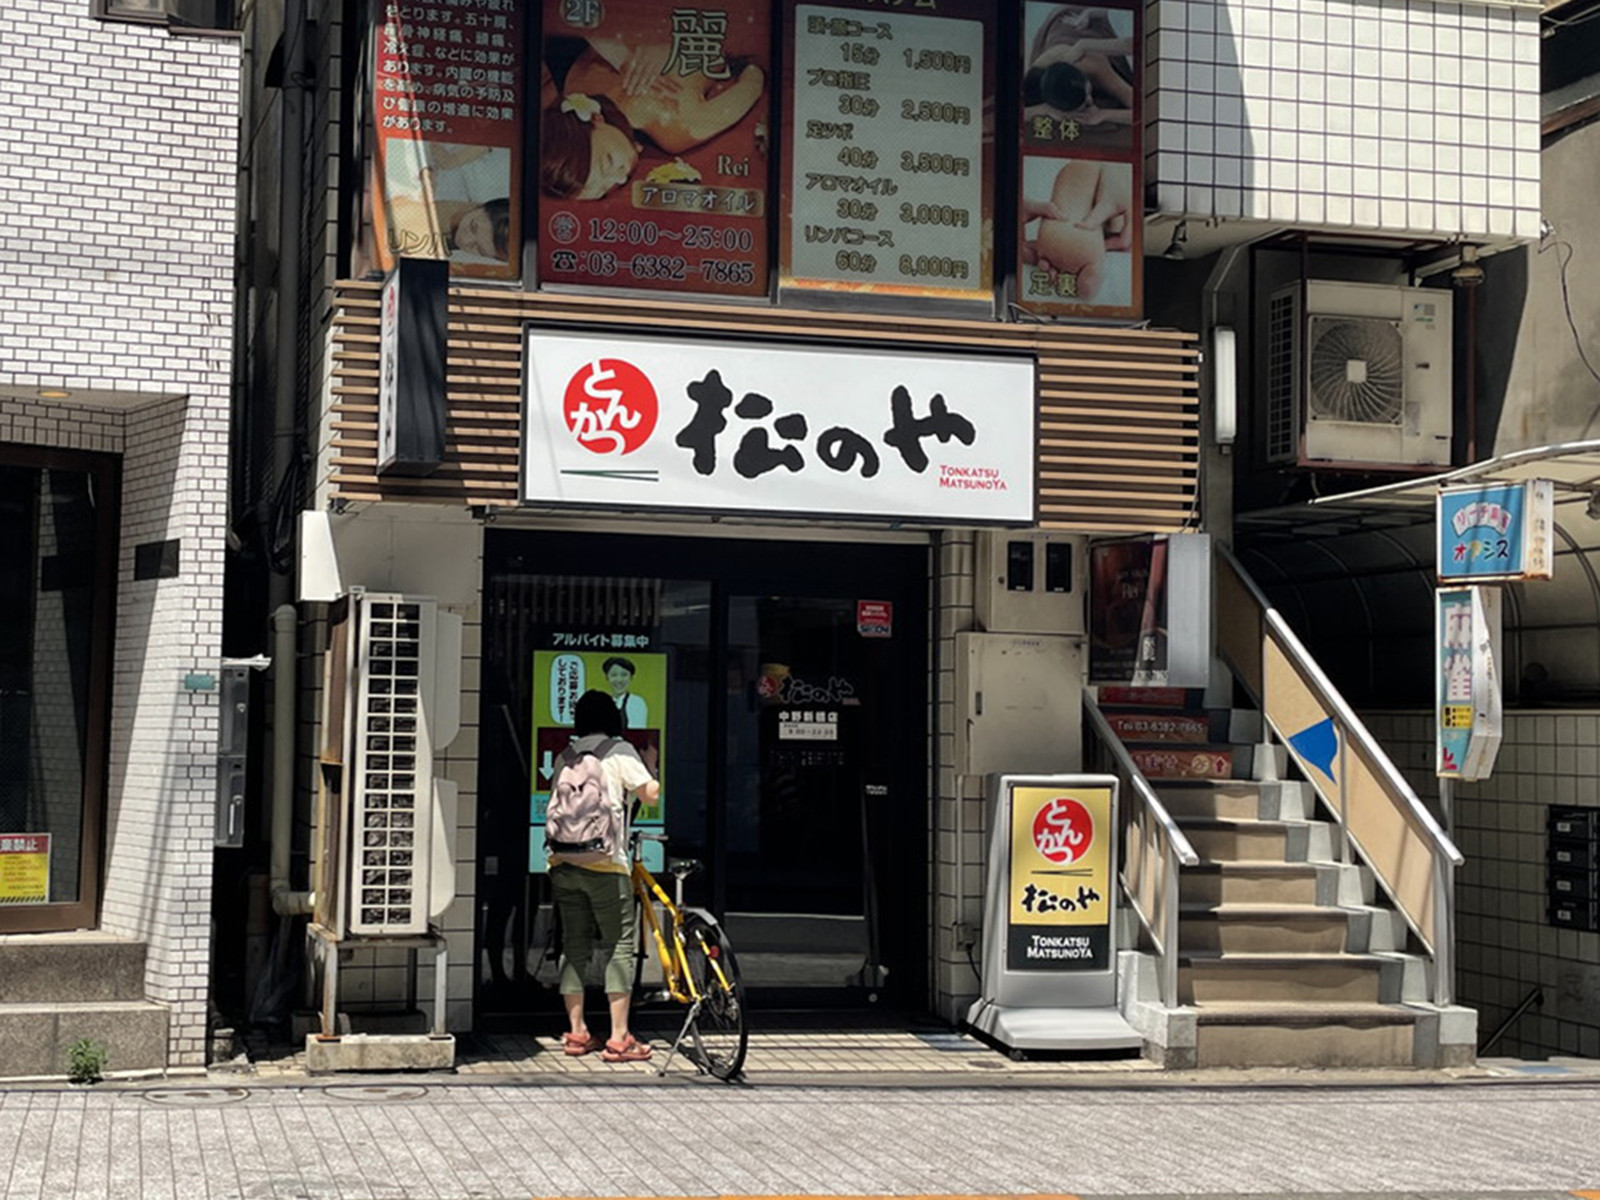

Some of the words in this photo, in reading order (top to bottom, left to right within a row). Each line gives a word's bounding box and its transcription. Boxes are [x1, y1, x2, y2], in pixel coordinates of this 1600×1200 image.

[566, 0, 599, 24] 2F
[661, 8, 731, 80] 麗
[839, 42, 881, 66] 15分
[902, 47, 972, 75] 1,500円
[838, 94, 880, 118] 30分
[901, 99, 971, 126] 2,500円
[1032, 116, 1080, 142] 整体
[717, 154, 750, 177] Rei
[837, 147, 879, 170] 40分
[901, 150, 970, 176] 3,500円
[805, 172, 899, 197] アロマオイル
[641, 186, 757, 212] アロマオイル
[836, 198, 879, 222] 30分
[899, 202, 969, 228] 3,000円
[835, 250, 877, 274] 60分
[1029, 270, 1080, 299] 足裏
[569, 359, 643, 456] とんかつ
[675, 368, 976, 480] 松のや
[938, 476, 1008, 492] MATSUNOYA
[939, 464, 1000, 479] TONKATSU
[552, 632, 650, 648] アルバイト募集中
[779, 675, 855, 704] 松のや
[1036, 799, 1084, 865] とんかつ
[1020, 883, 1101, 913] 松のや
[1026, 946, 1094, 960] MATSUNOYA
[1031, 934, 1090, 948] TONKATSU
